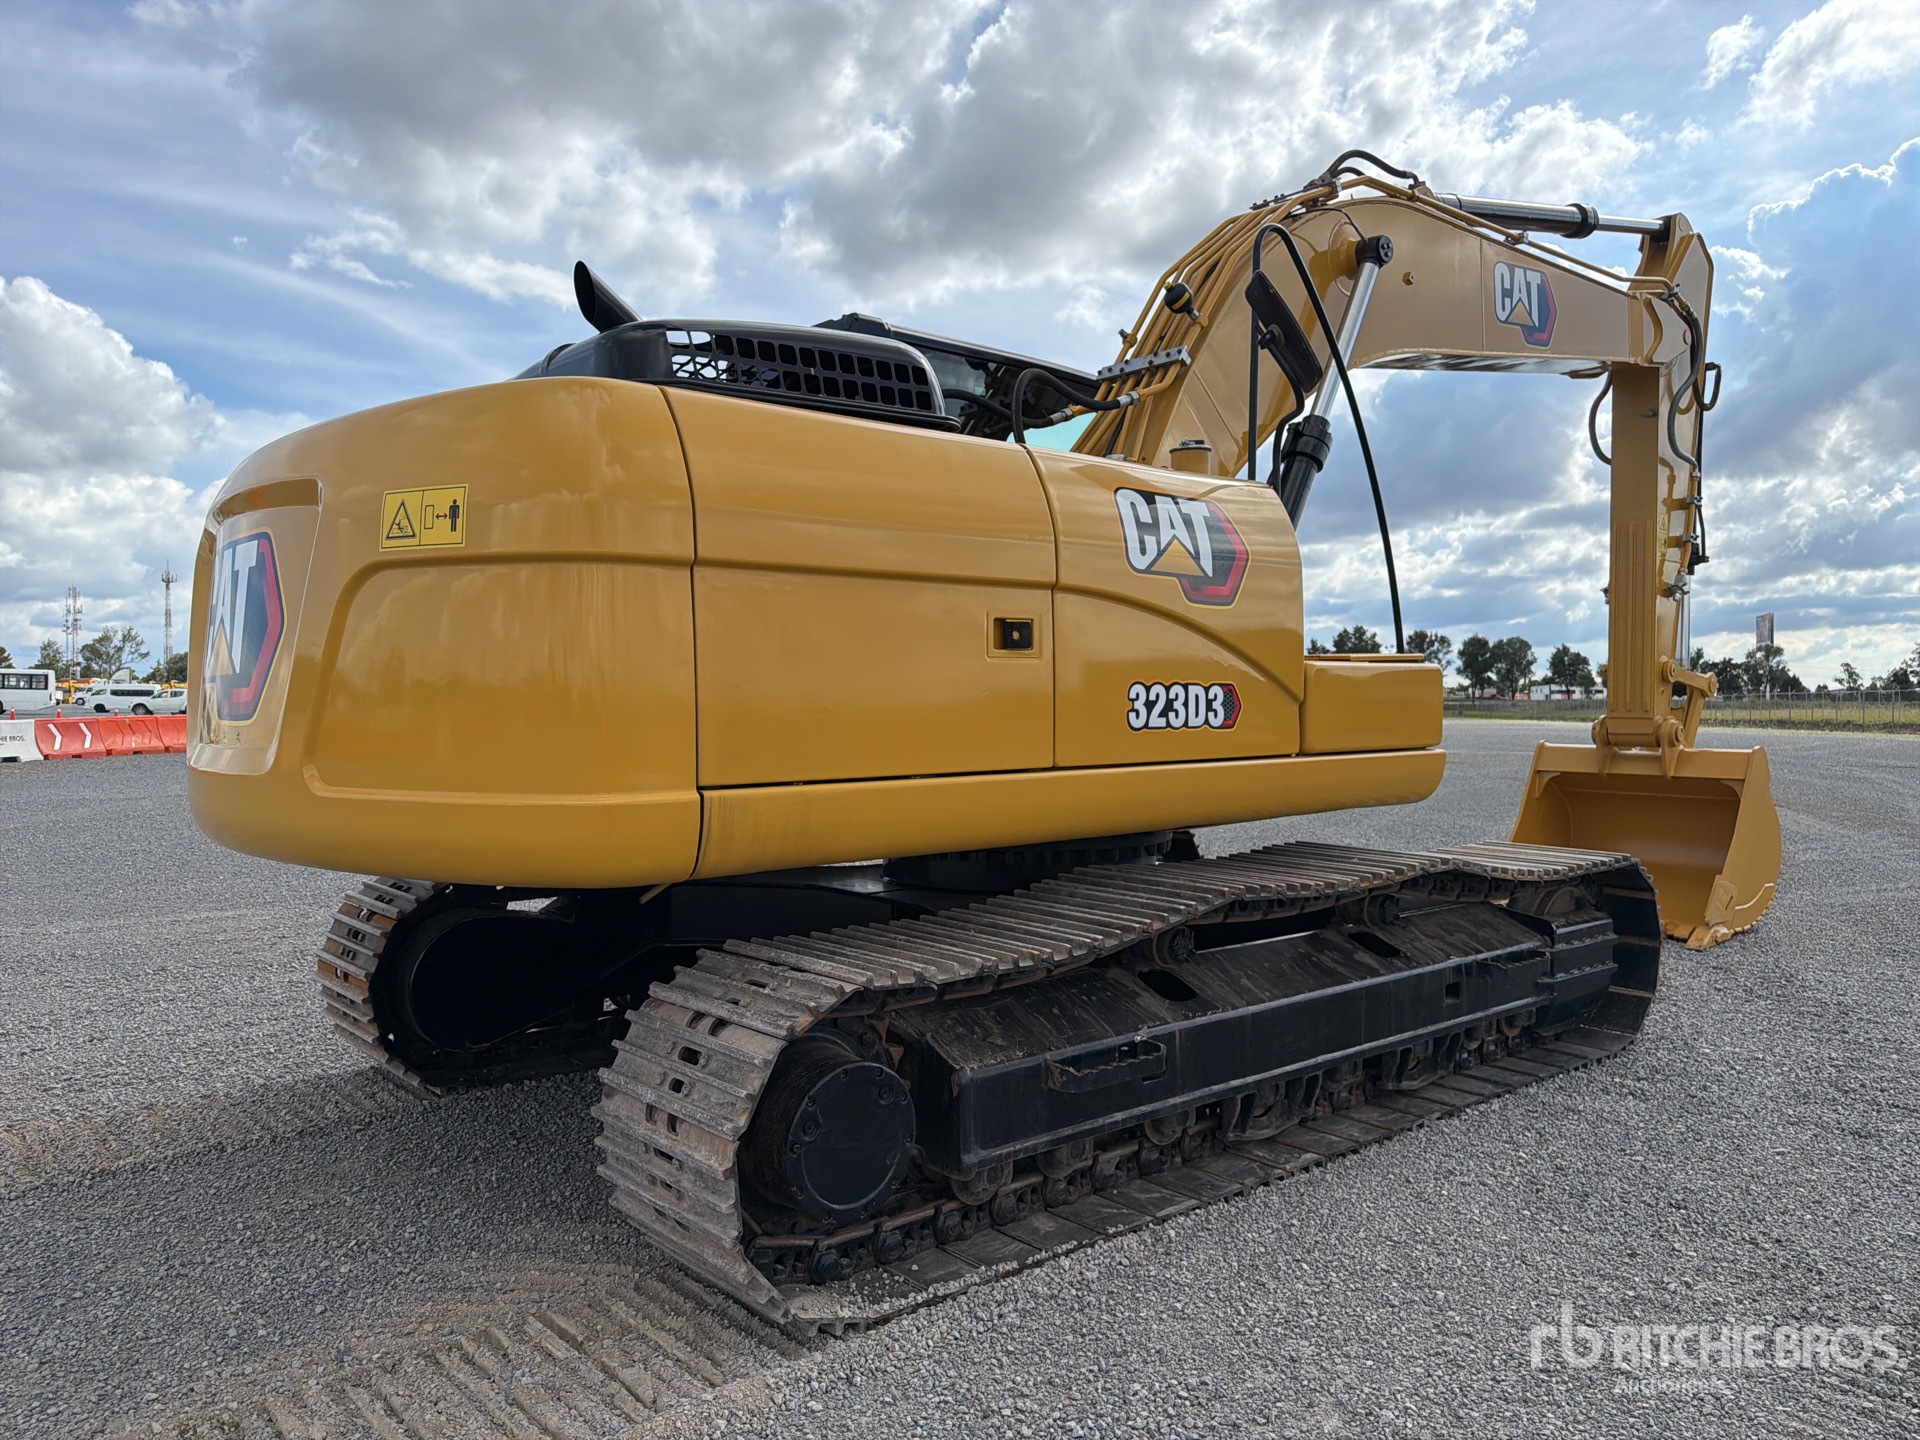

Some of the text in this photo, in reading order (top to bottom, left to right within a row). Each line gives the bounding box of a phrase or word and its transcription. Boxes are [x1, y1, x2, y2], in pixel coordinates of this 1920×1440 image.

[1495, 261, 1542, 327] CAT
[1115, 487, 1214, 578] CAT
[1127, 682, 1225, 729] 323D3
